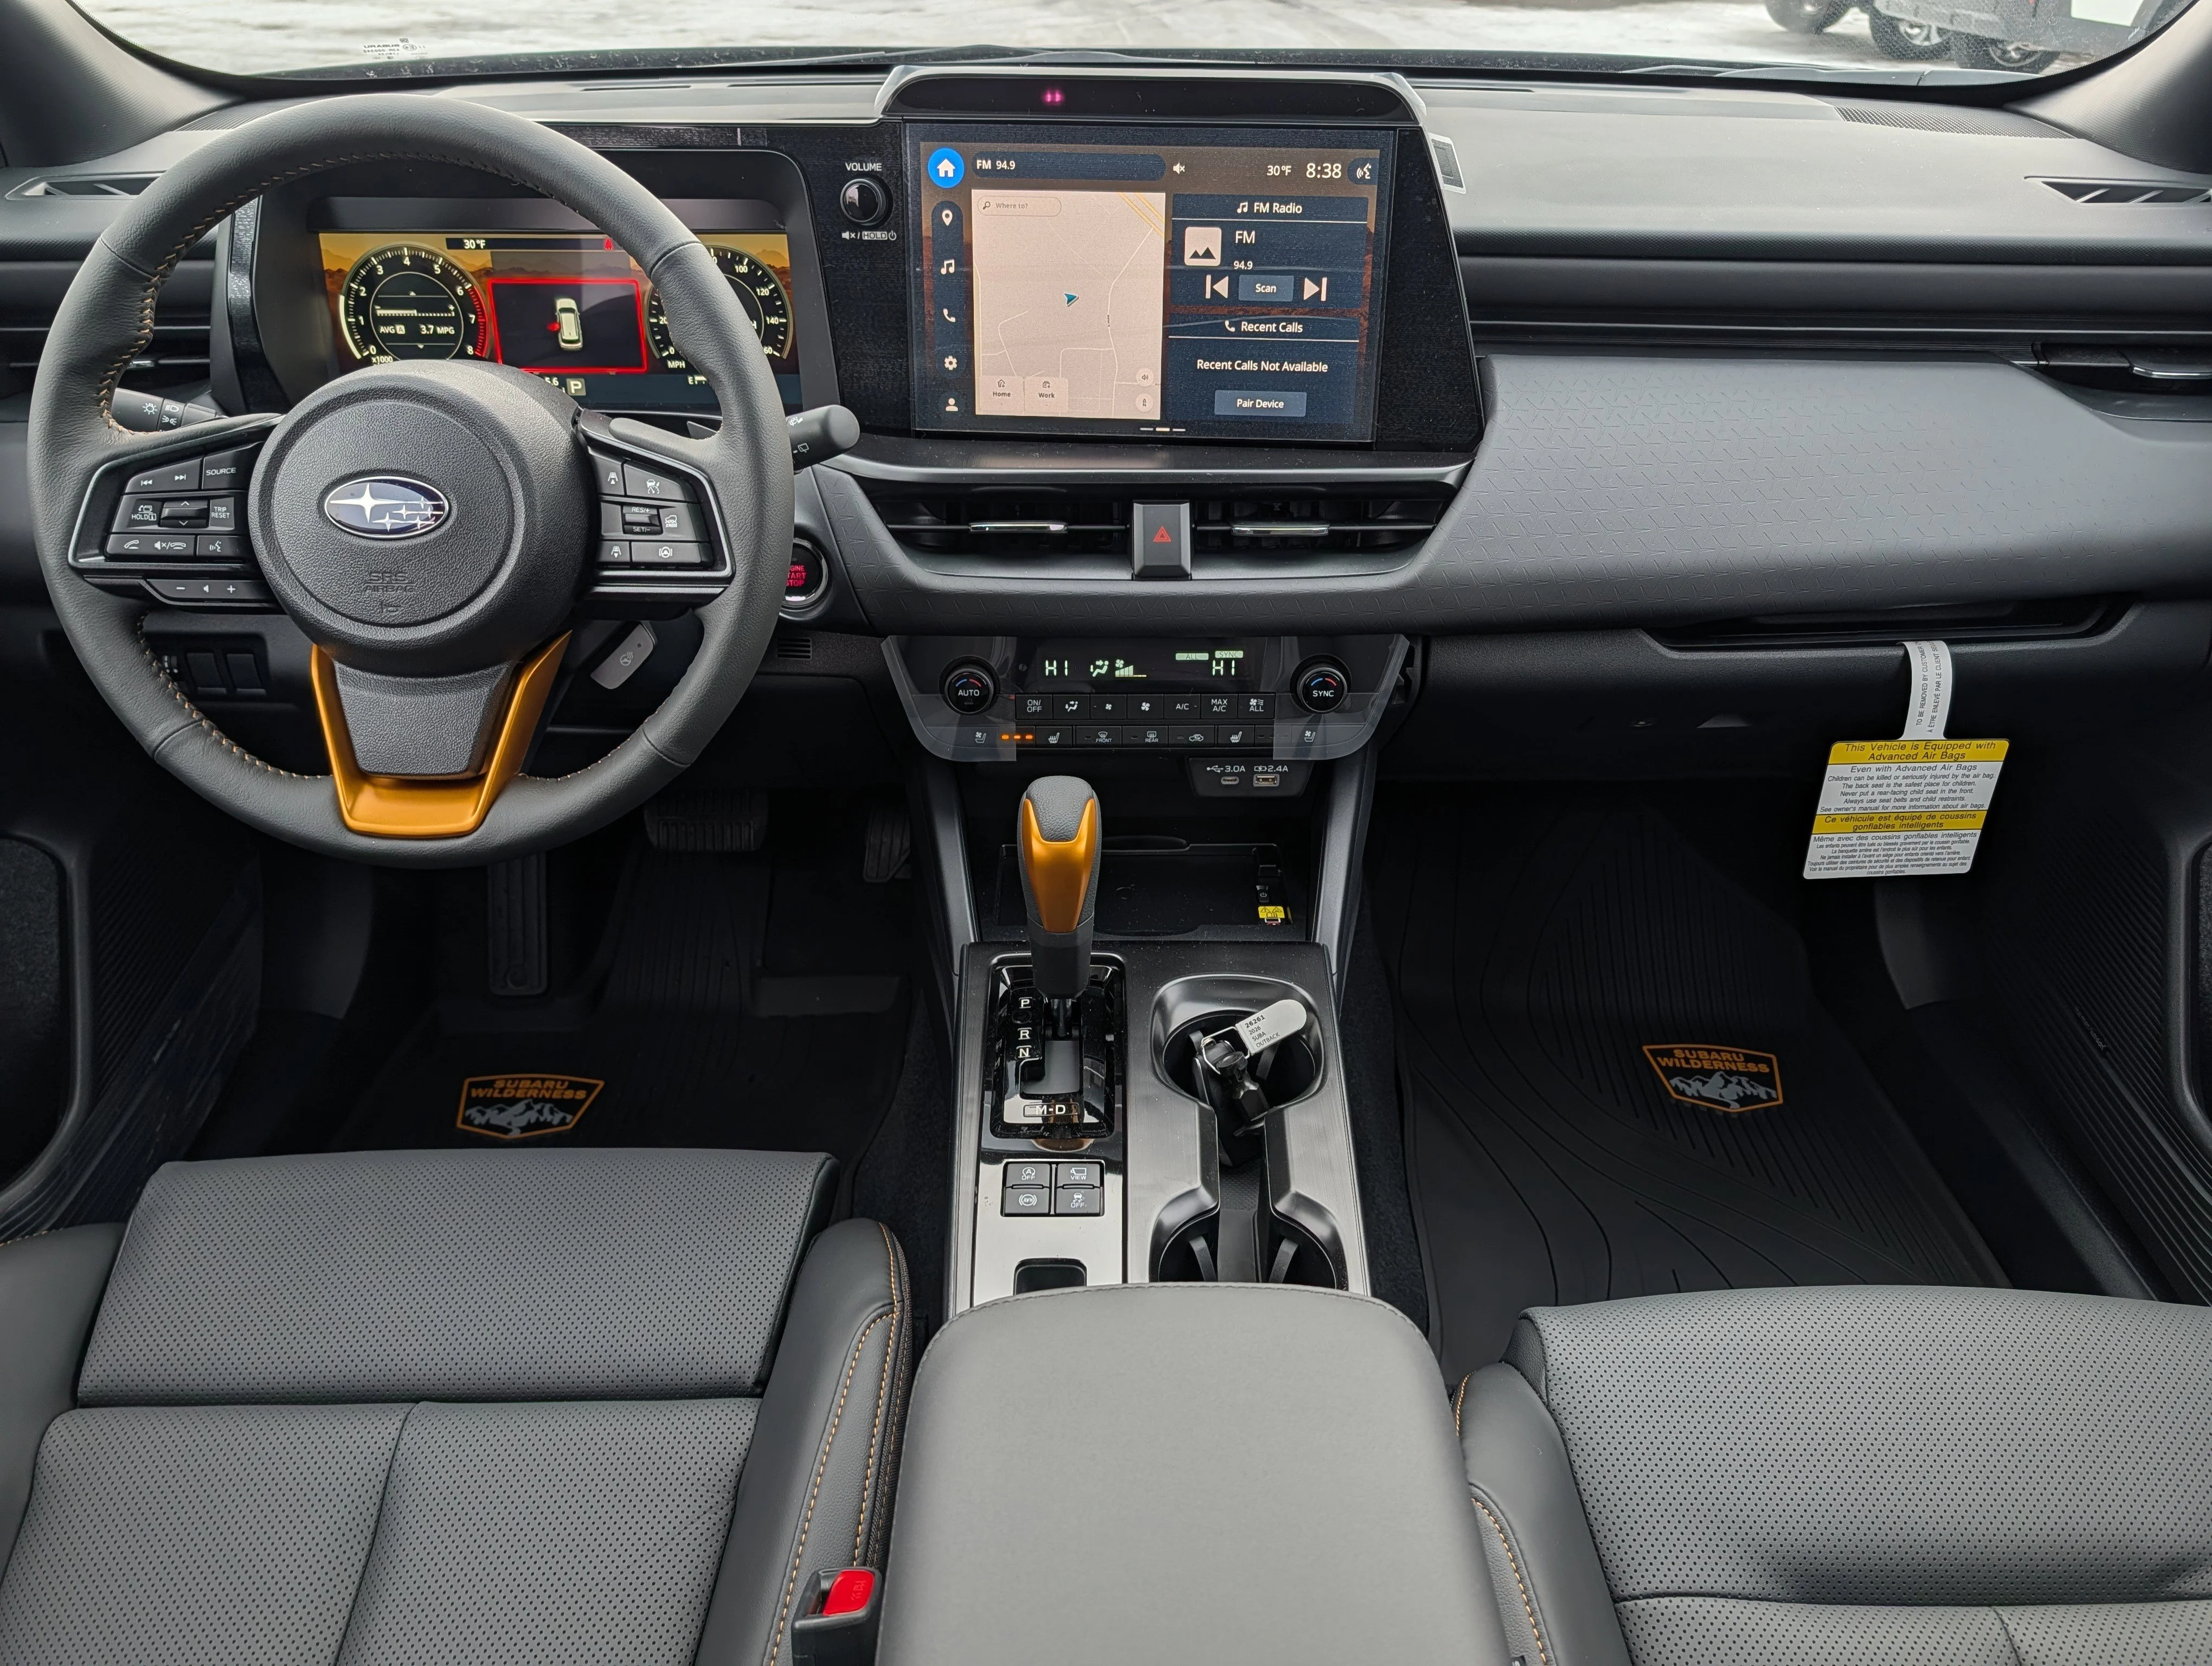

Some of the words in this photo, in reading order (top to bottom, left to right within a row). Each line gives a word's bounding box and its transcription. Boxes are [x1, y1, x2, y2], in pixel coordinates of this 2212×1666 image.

[845, 163, 882, 171] VOLUME
[976, 160, 991, 170] FM
[996, 161, 1015, 170] 94.9
[1266, 165, 1291, 176] 30°F
[1306, 163, 1342, 179] 8:38
[1254, 203, 1269, 213] FM
[1273, 203, 1302, 214] Radio
[1235, 230, 1256, 244] FM
[463, 239, 486, 249] 30°F
[403, 257, 410, 266] 4
[1233, 261, 1253, 270] 94.9
[376, 265, 384, 275] 3
[433, 265, 441, 274] 5
[735, 265, 748, 273] 100
[359, 287, 366, 296] 2
[456, 286, 464, 296] 6
[756, 288, 769, 296] 120
[1255, 284, 1277, 293] Scan
[358, 316, 364, 325] 1
[468, 314, 476, 323] 7
[380, 326, 395, 334] AVG
[420, 325, 434, 334] 3.7
[436, 326, 455, 335] MPG
[1241, 322, 1277, 333] Recent
[1279, 322, 1303, 333] Calls
[369, 345, 377, 355] 0
[467, 345, 474, 355] 8
[667, 360, 686, 368] MPH
[1197, 359, 1232, 370] Recent
[1234, 360, 1258, 371] Calls
[1261, 361, 1280, 371] Not
[1282, 362, 1328, 373] Available
[688, 376, 693, 385] E
[570, 381, 582, 394] P
[1237, 399, 1253, 408] Pair
[1256, 399, 1284, 408] Device
[206, 467, 236, 476] SOURCE
[369, 572, 408, 583] SRS
[1917, 646, 1928, 672] CUSTOMER
[1933, 653, 1941, 670] CLIENT
[1045, 659, 1068, 677] HI
[1212, 659, 1235, 676] HI
[1919, 683, 1928, 709] REMOVED
[1932, 693, 1940, 713] ENLEVÉ
[1846, 744, 1865, 752] This
[1924, 742, 1972, 751] Equipped
[1868, 752, 1918, 760] Advanced
[1940, 752, 1966, 761] Bags
[1894, 813, 1922, 822] équipé
[1853, 823, 1895, 832] gonflables
[1899, 822, 1944, 830] intelligents
[1245, 1015, 1265, 1028] 26261
[1020, 1030, 1030, 1040] R
[1248, 1026, 1261, 1035] 2026
[1252, 1031, 1266, 1042] SUBA
[1256, 1031, 1281, 1048] OUTBACK
[1020, 1048, 1030, 1057] N
[1673, 1048, 1744, 1062] SUBARU
[1657, 1056, 1770, 1073] WILDERNESS
[493, 1079, 569, 1090] SUBARU
[471, 1087, 587, 1099] WILDERNESS
